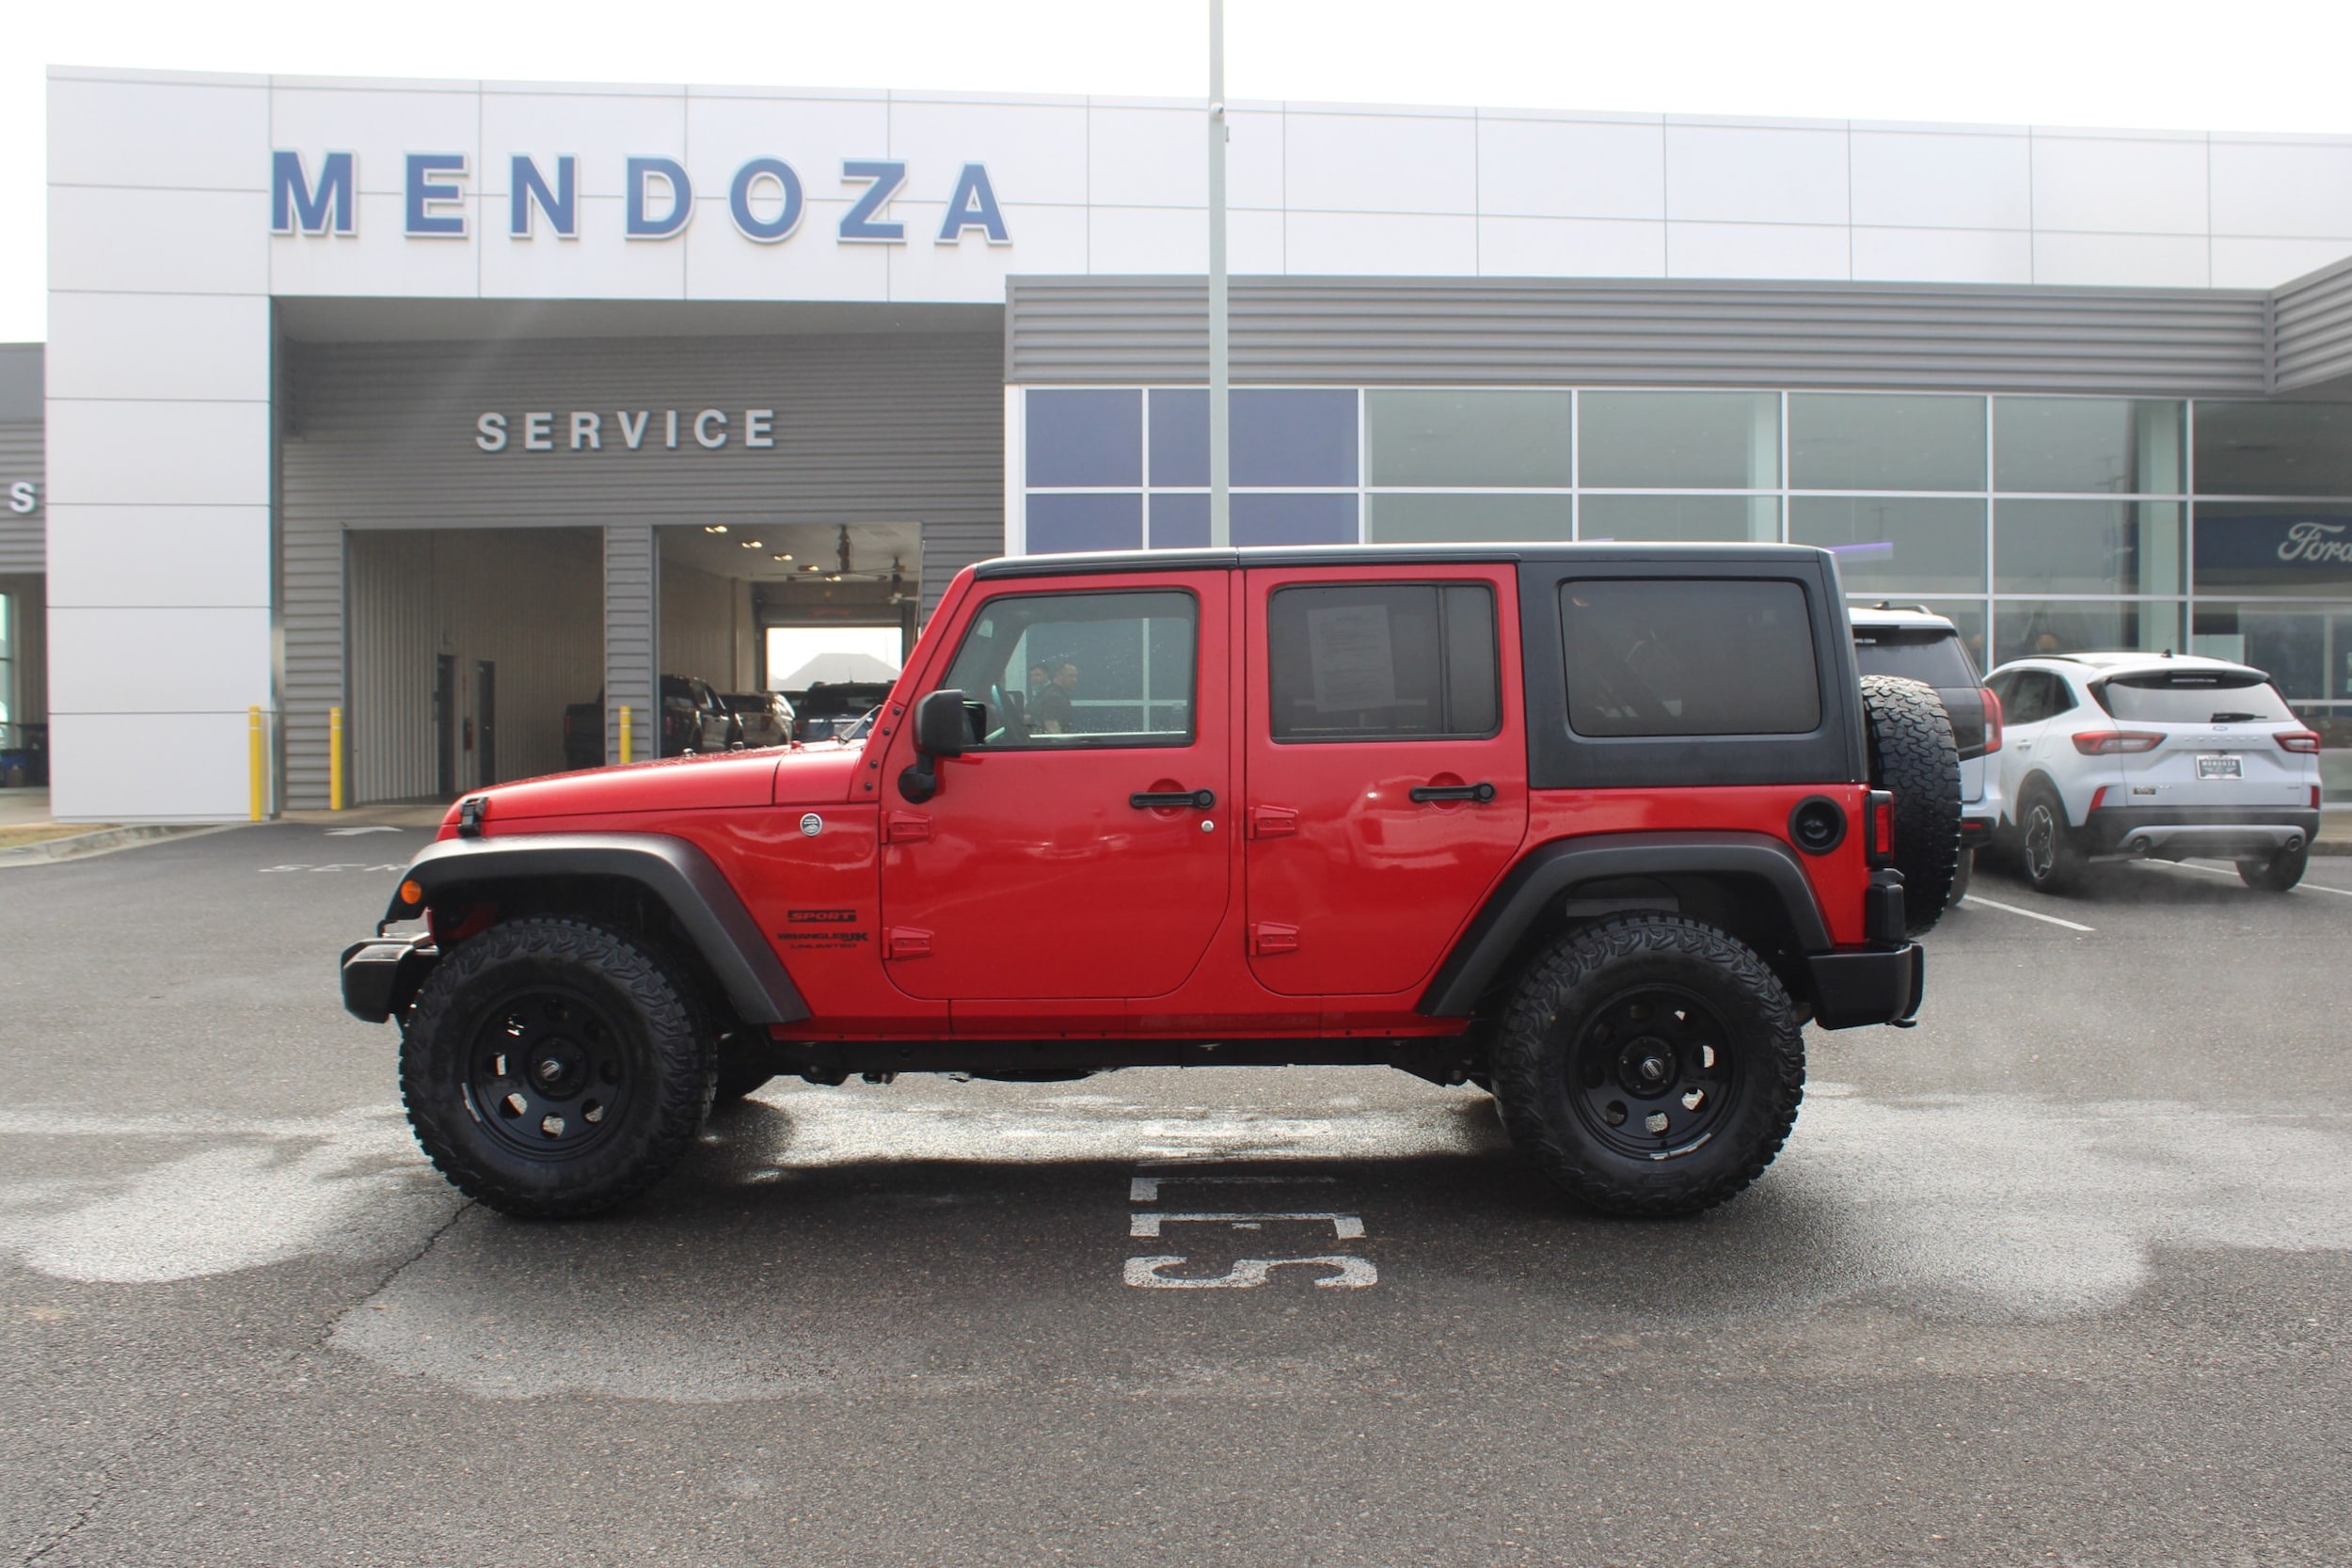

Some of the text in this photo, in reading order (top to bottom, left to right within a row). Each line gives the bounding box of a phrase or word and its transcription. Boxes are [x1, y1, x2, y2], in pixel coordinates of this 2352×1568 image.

[269, 149, 1013, 245] MENDOZA
[474, 407, 777, 452] SERVICE
[8, 481, 36, 514] S
[790, 911, 855, 921] SPORT
